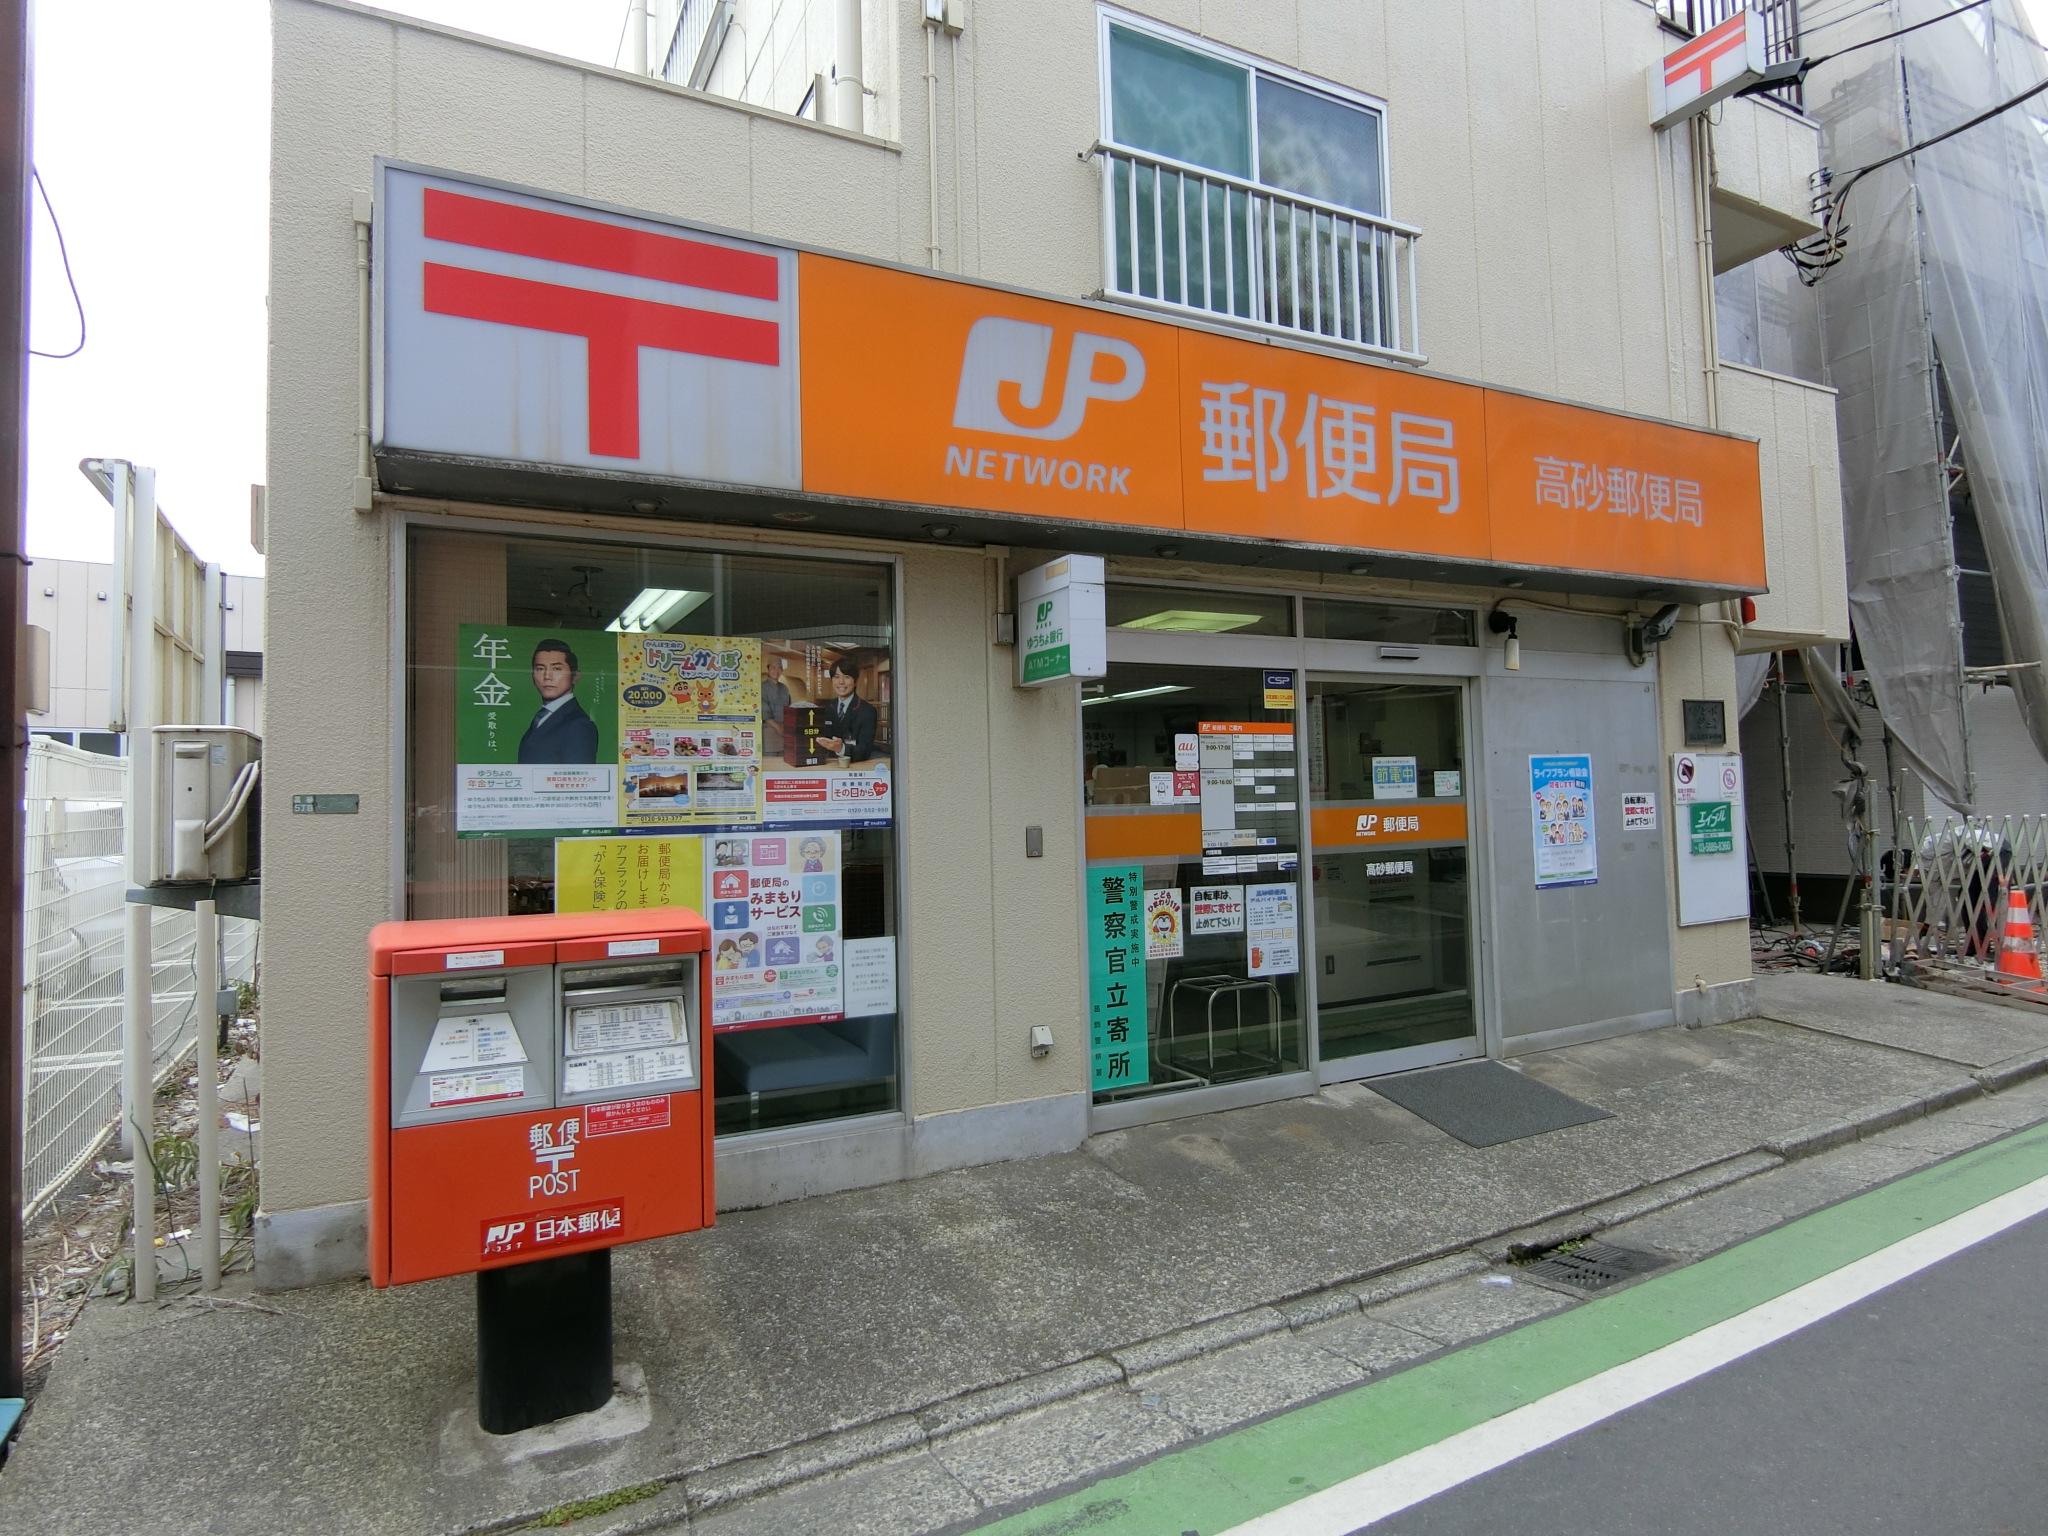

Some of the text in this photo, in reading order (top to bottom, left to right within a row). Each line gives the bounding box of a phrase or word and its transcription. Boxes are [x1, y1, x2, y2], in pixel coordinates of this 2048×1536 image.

[1199, 381, 1461, 514] 郵便局
[944, 444, 1133, 496] NETWORK
[1533, 455, 1703, 528] 高砂郵便局
[645, 641, 684, 649] かんぽ生命の
[1026, 628, 1064, 650] ゆうちょ銀行
[647, 648, 740, 672] ドリームかんぽ
[1027, 653, 1068, 671] ATMコーナー
[472, 632, 513, 707] 年金
[1267, 676, 1290, 685] CSP
[627, 690, 663, 699] 20,000
[487, 711, 498, 752] 受取りは、
[1177, 743, 1196, 751] au
[477, 769, 513, 777] ゆうちょの
[1376, 765, 1414, 784] 節電中
[1533, 767, 1588, 779] ライフプラン相談会
[467, 779, 523, 788] 年金サービス
[833, 787, 875, 798] その日から
[1382, 816, 1419, 833] 郵便局
[1694, 804, 1728, 828] エイブル
[615, 844, 628, 910] アフラックの
[637, 843, 649, 909] お届けしま
[658, 842, 671, 905] 郵便局から
[1365, 860, 1414, 877] 高砂郵便局
[750, 877, 790, 889] 郵便局の
[750, 890, 801, 905] みまもり
[1153, 890, 1172, 900] こども
[1194, 890, 1232, 902] 自転車は、
[750, 905, 802, 920] サービス
[1194, 903, 1241, 915] 壁際に寄せて
[1128, 871, 1140, 968] 特別警戒実施中
[1101, 876, 1131, 1079] 警察官立寄所
[529, 1117, 581, 1150] 郵便
[529, 1169, 581, 1199] POST
[535, 1207, 622, 1242] 日本郵便
